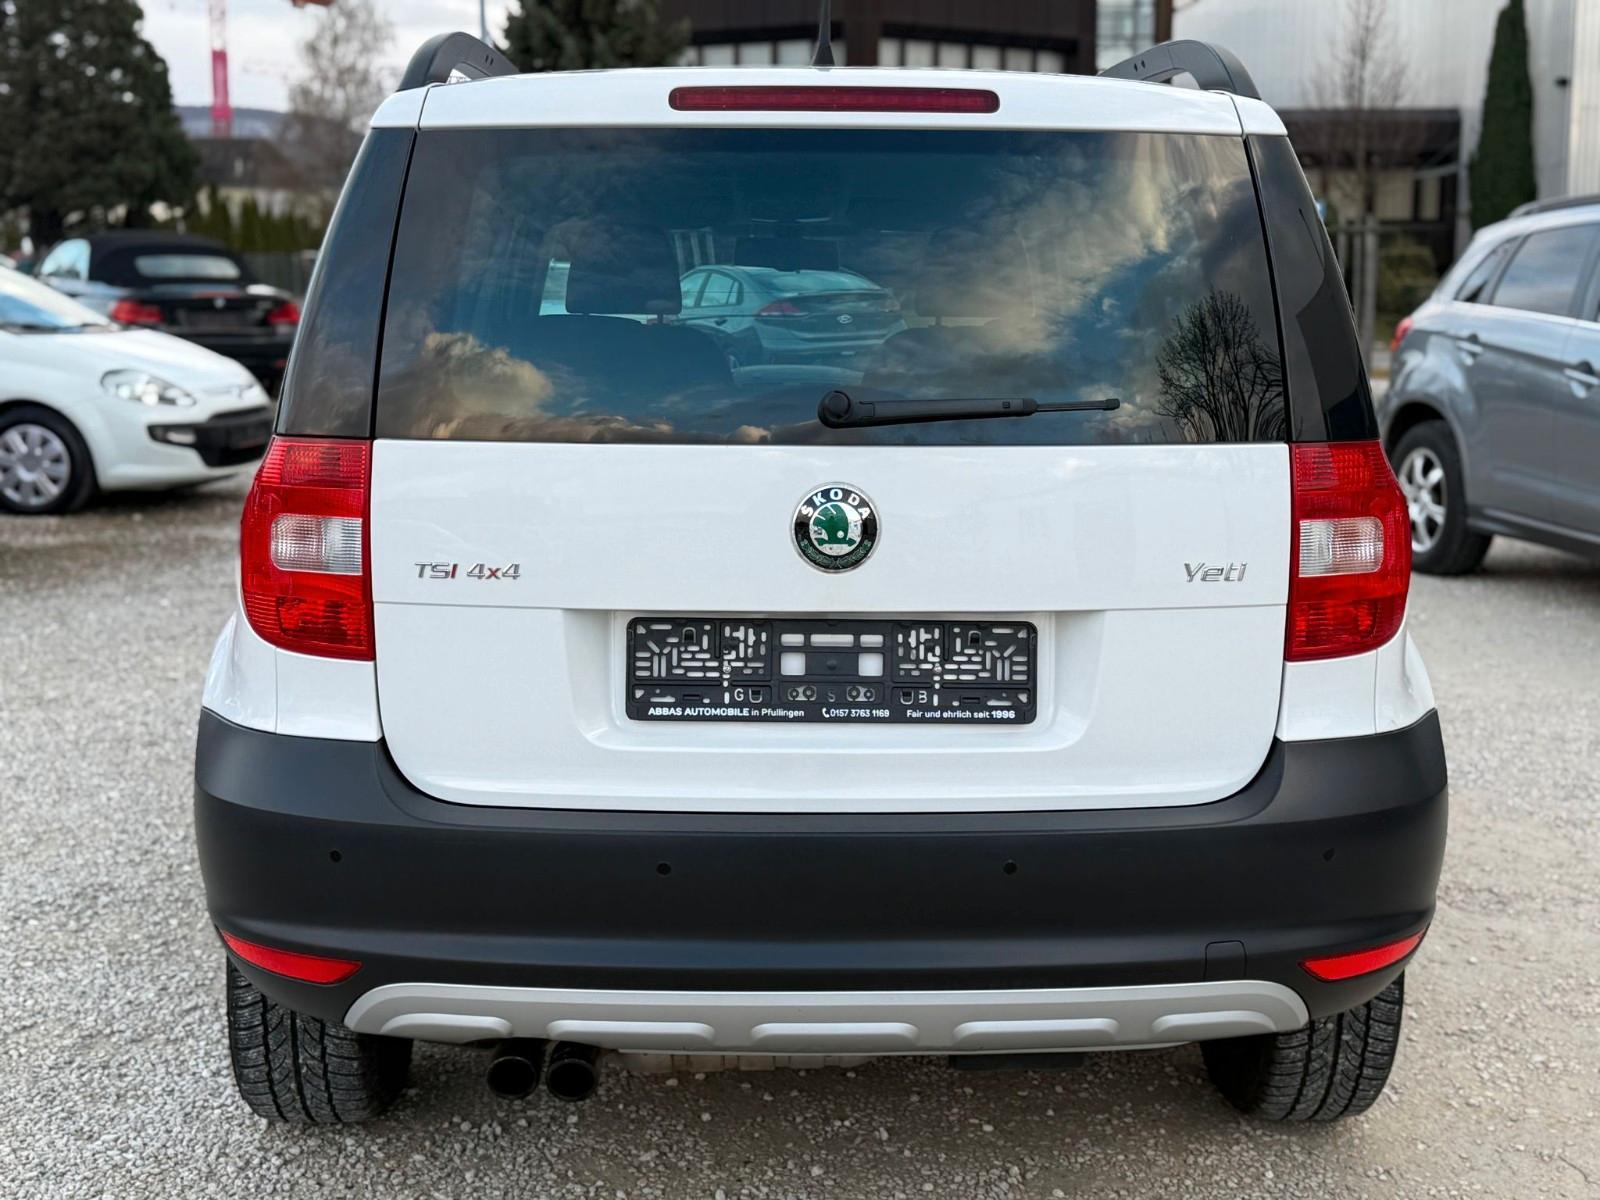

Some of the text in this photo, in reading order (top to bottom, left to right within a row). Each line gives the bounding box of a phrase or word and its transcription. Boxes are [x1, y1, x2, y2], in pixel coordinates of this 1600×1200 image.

[415, 562, 521, 580] TSI 4x4
[1183, 562, 1247, 583] Yeti
[734, 688, 744, 701] G
[648, 707, 804, 718] ABBAS AUTOMOBILE in Pfullingen
[830, 708, 848, 717] 0157
[872, 708, 889, 717] 1169
[906, 709, 1016, 719] Fair und ehrlich seit 1996
